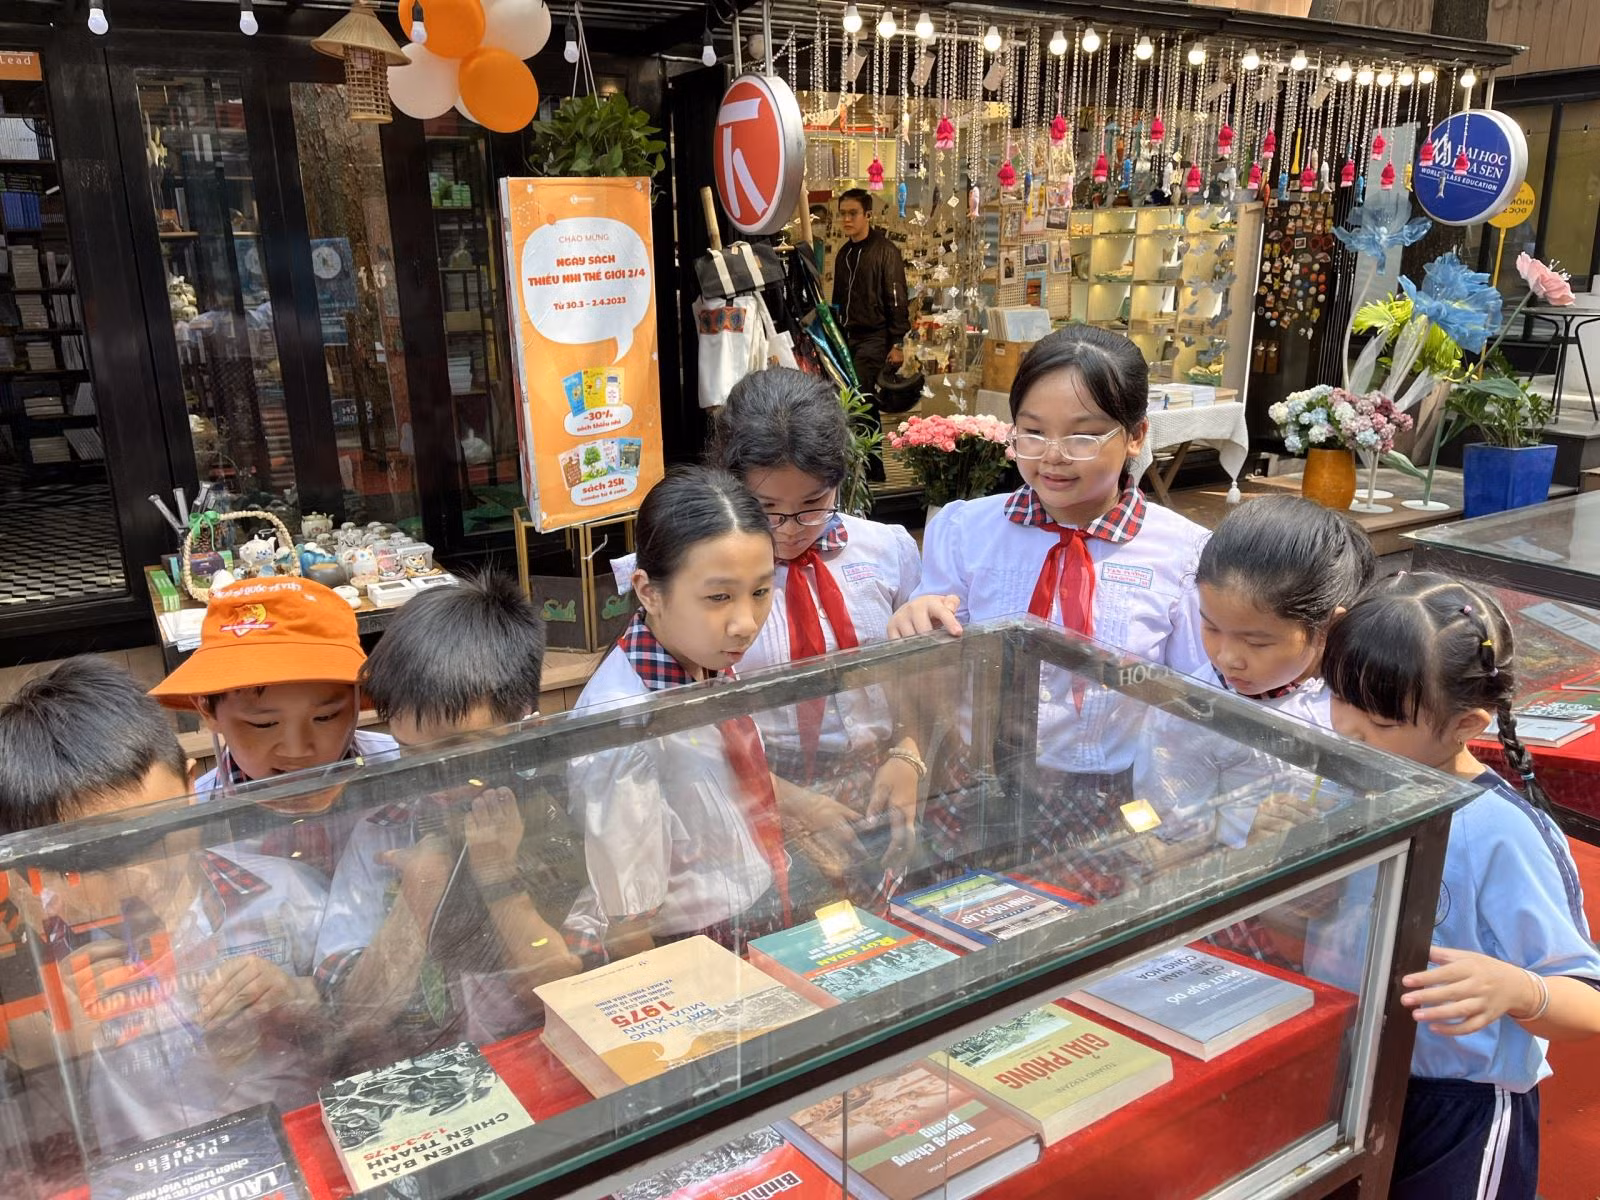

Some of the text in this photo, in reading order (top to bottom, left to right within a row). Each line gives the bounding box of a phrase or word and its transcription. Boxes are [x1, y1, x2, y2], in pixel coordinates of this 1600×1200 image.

[1445, 173, 1461, 183] LASS
[1462, 177, 1498, 191] EDUCATION
[1479, 165, 1504, 179] SEN
[562, 273, 581, 284] NHI
[628, 268, 646, 278] 2/4
[566, 301, 584, 309] 30.3
[592, 296, 627, 307] 2.4.2023
[611, 1000, 676, 1029] 1975
[134, 1134, 230, 1172] ELLSBERG
[151, 1145, 219, 1174] DANIEL
[367, 1139, 442, 1171] TRANH
